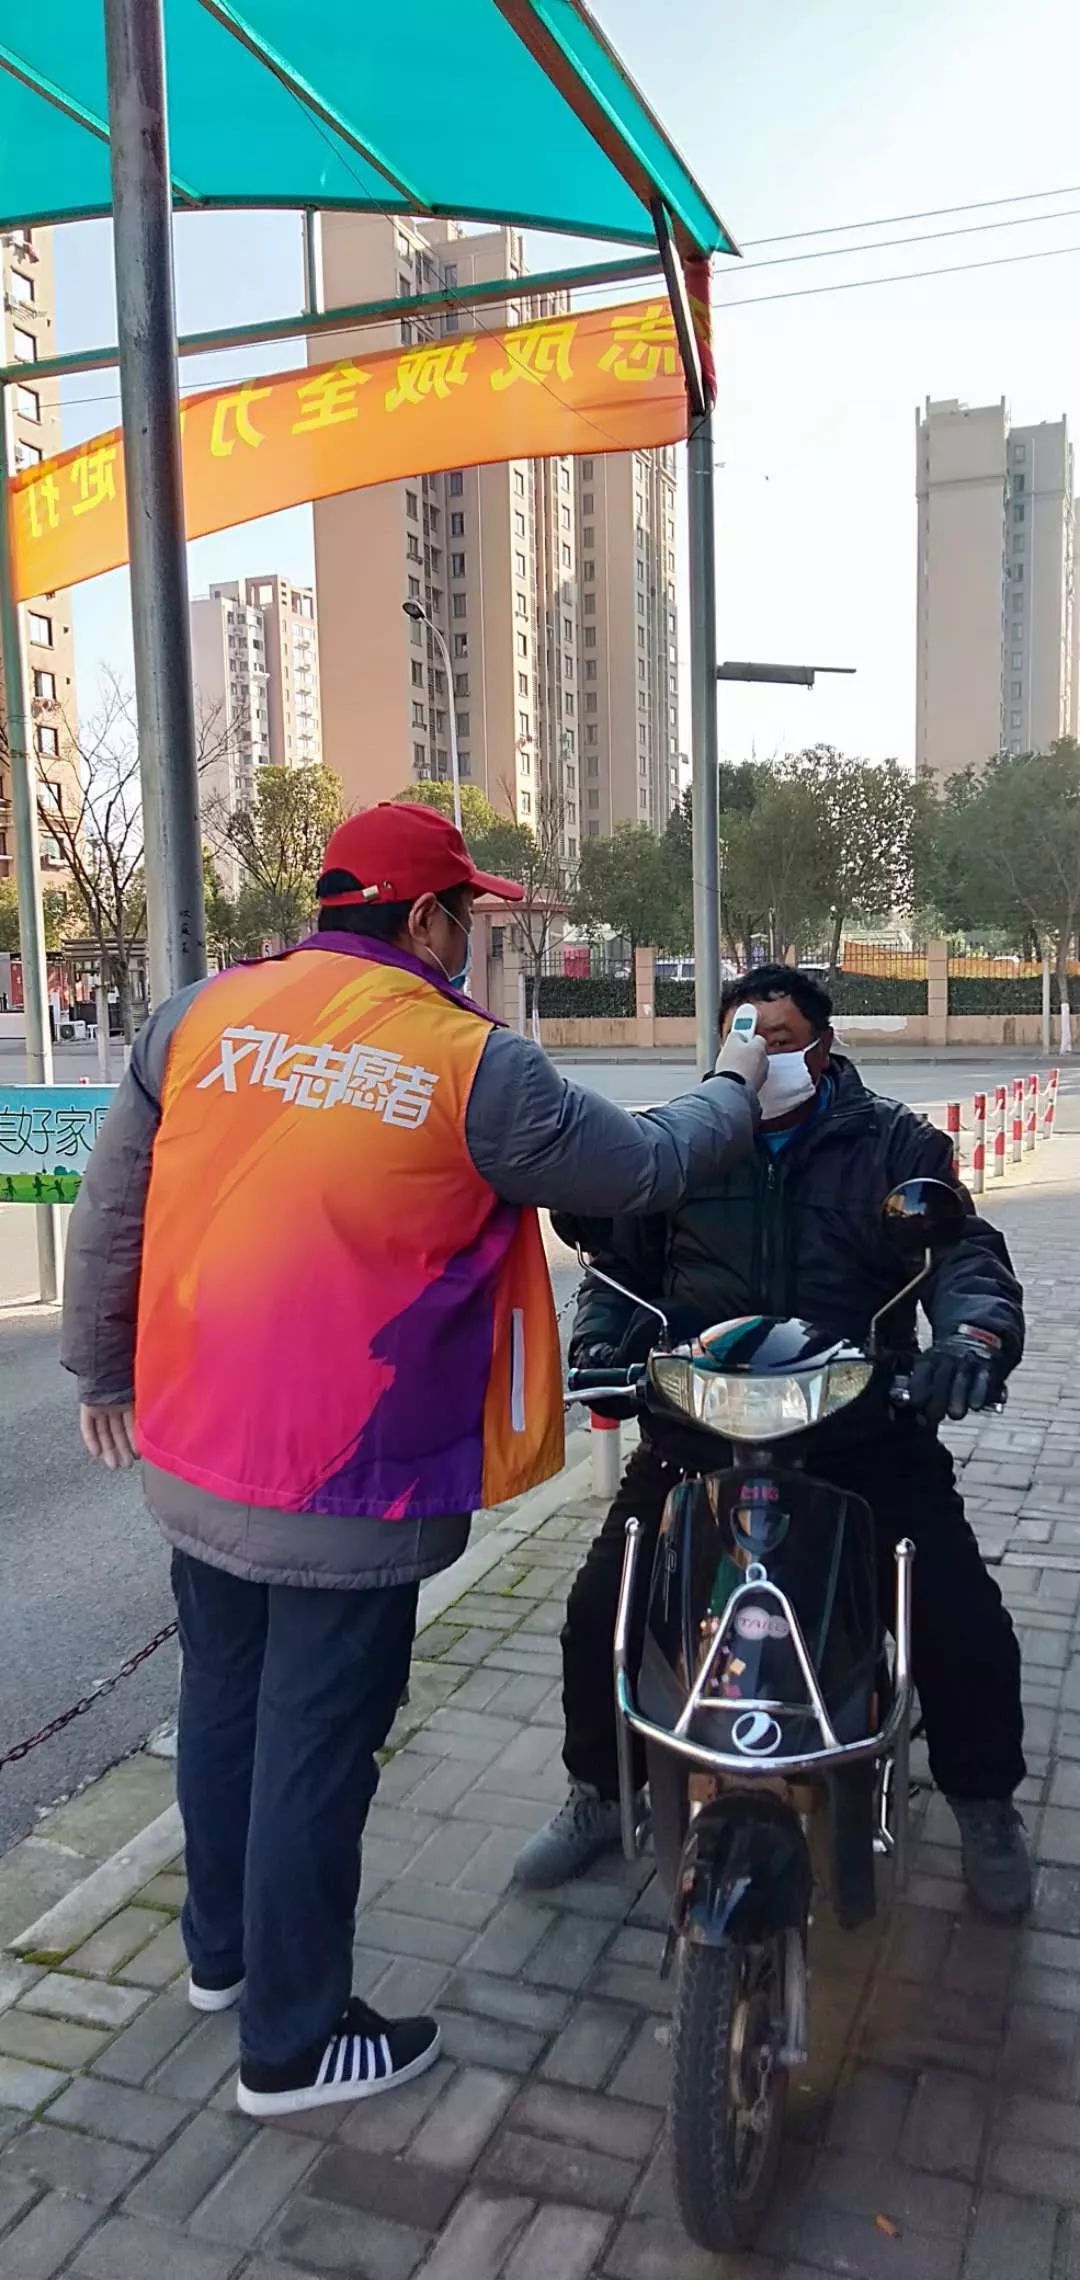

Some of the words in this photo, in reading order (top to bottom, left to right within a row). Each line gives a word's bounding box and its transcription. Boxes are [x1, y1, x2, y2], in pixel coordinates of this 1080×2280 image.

[196, 1025, 440, 1129] 文化志愿者
[0, 1106, 109, 1156] 美好家
